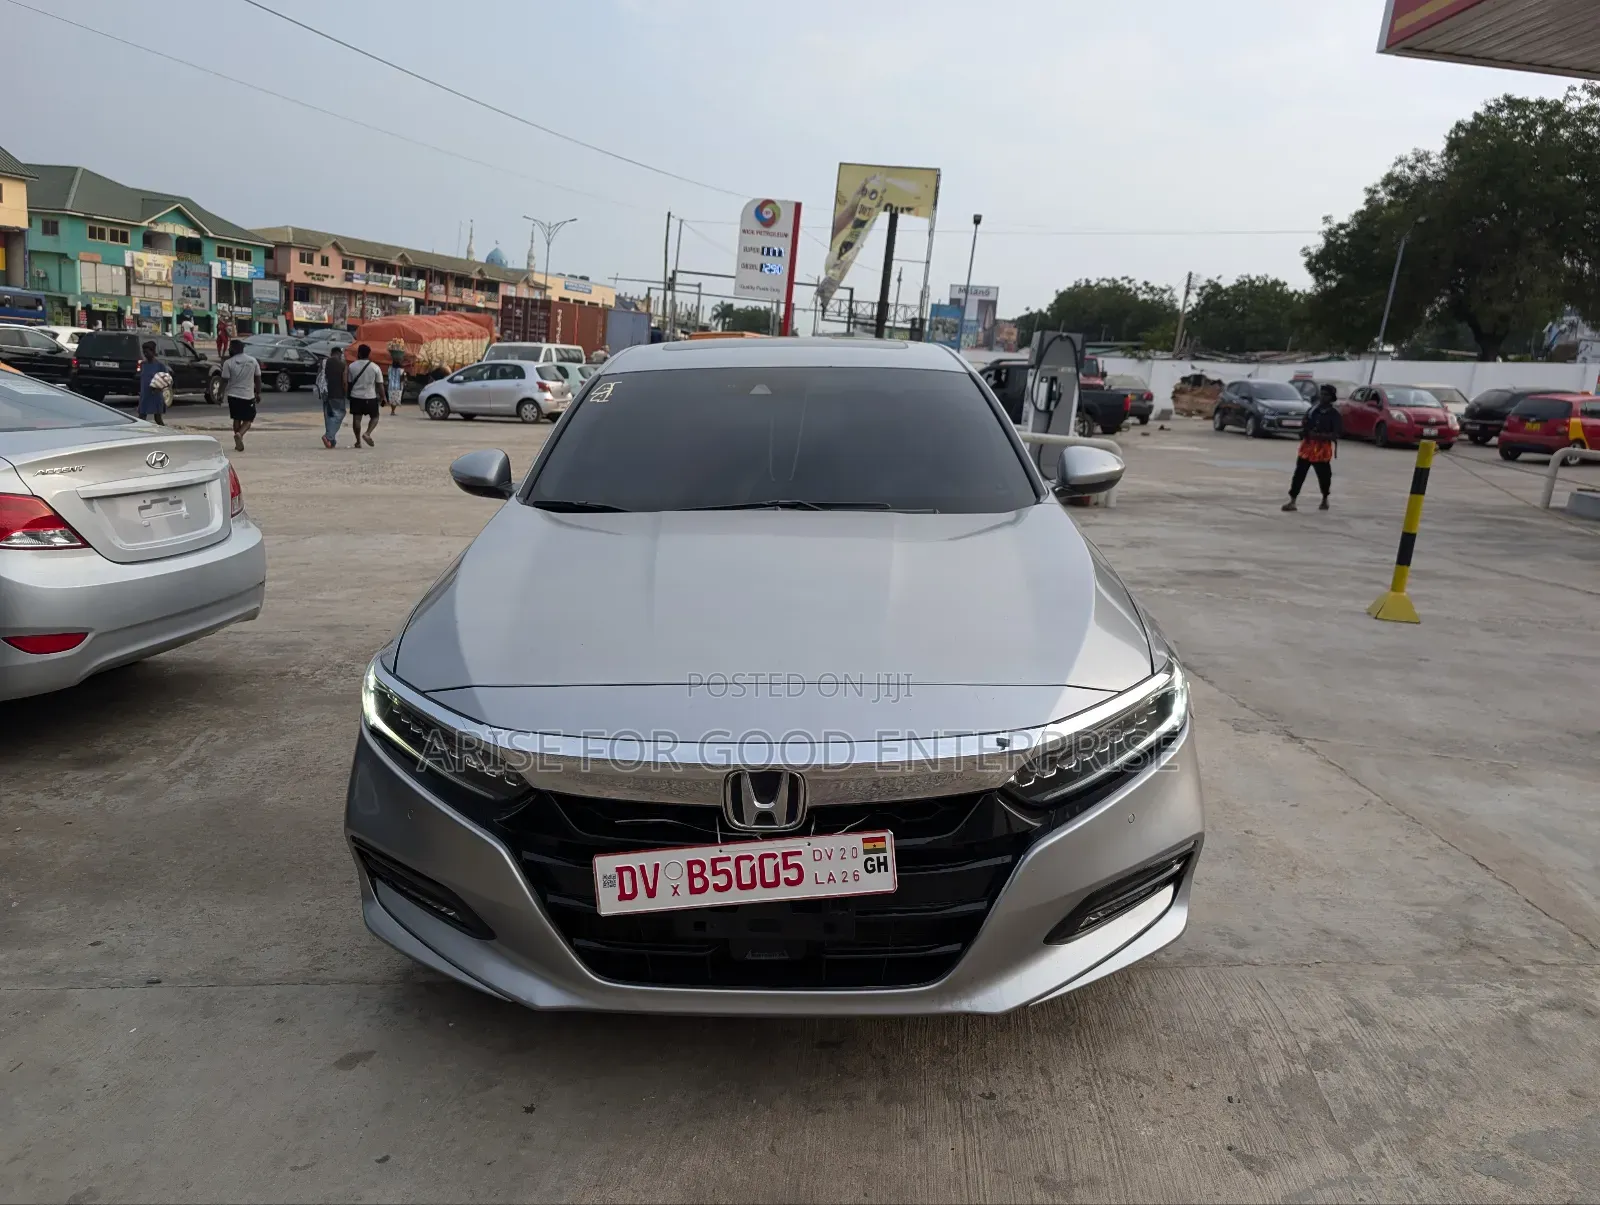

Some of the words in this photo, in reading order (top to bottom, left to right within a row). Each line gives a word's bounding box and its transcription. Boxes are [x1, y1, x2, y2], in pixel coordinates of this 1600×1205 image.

[33, 465, 85, 477] ACCENT
[812, 848, 834, 862] DV
[839, 846, 858, 860] 20
[863, 856, 889, 874] GH
[615, 862, 661, 901] DV
[686, 850, 805, 895] B5005
[814, 871, 837, 884] LA
[841, 869, 860, 883] 26
